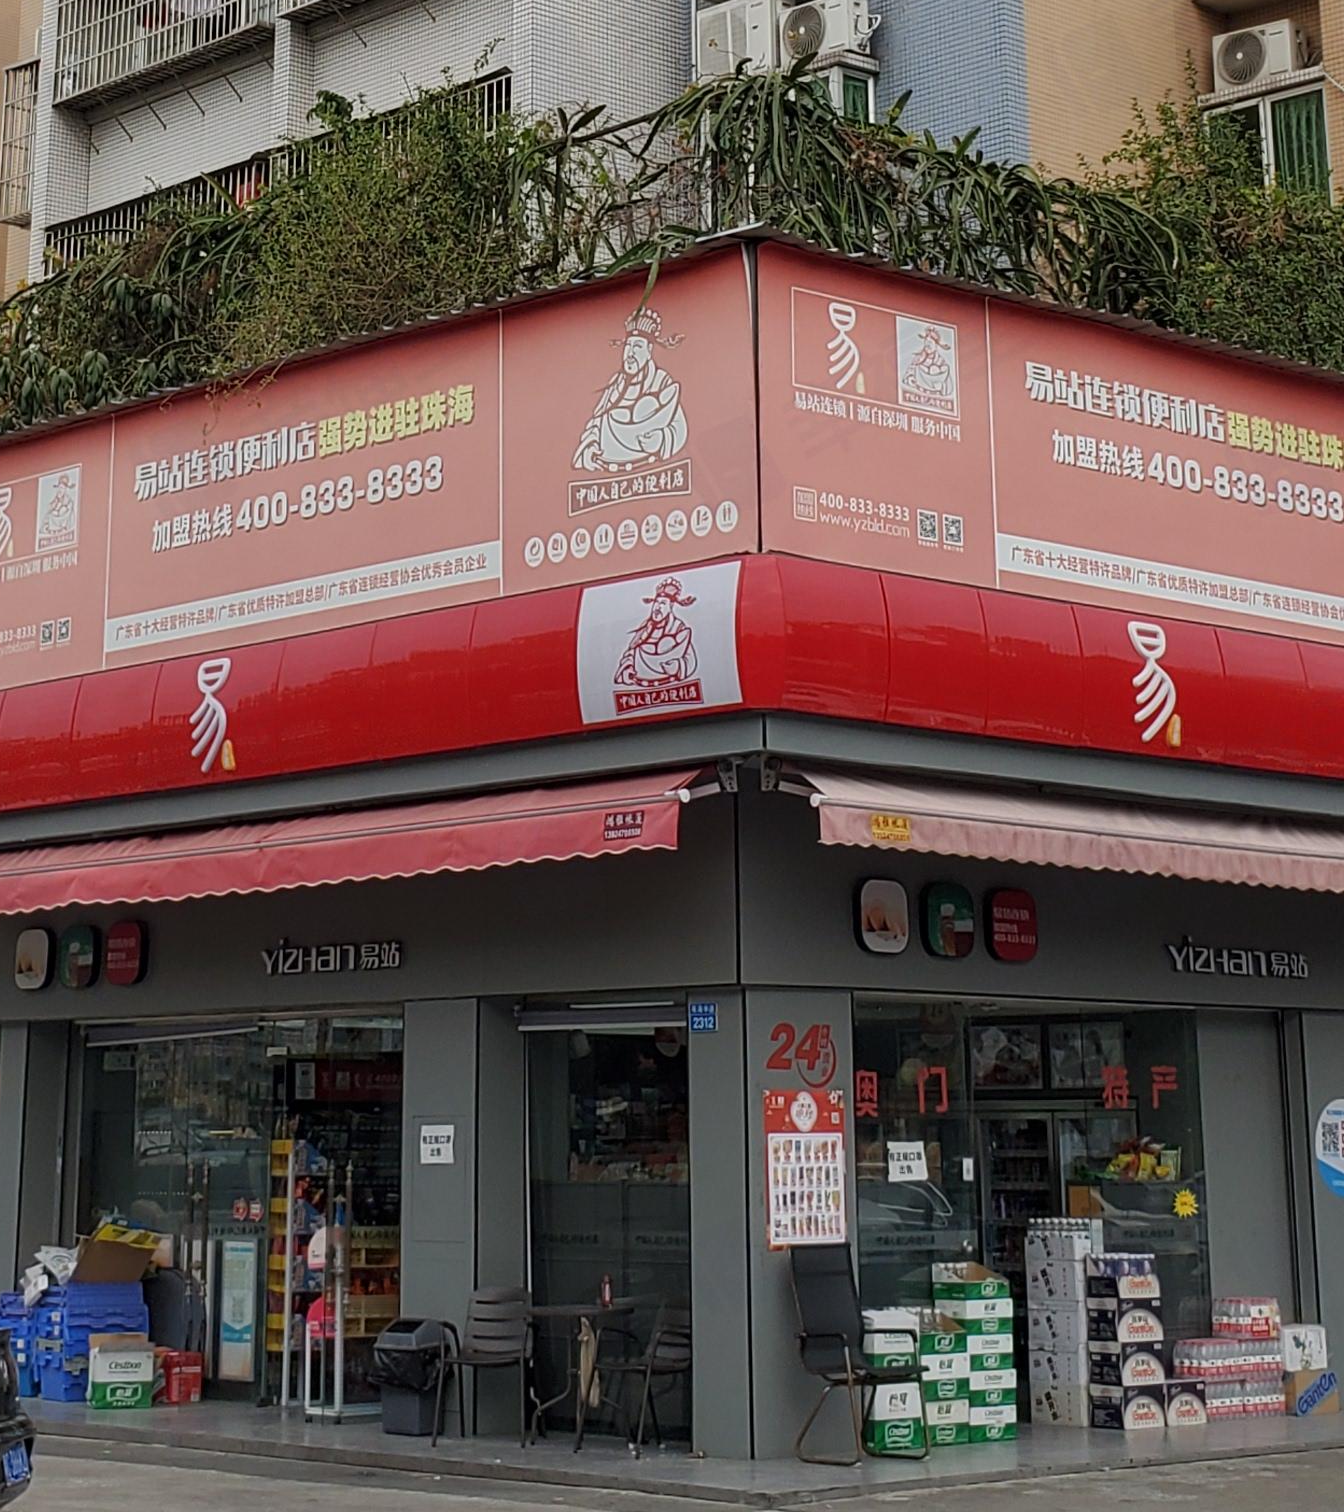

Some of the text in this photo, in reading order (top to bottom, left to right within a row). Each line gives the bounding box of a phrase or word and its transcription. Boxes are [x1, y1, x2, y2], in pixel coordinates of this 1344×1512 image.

[911, 416, 961, 442] 服务中国
[575, 468, 684, 507] 中国人自己的便利店
[819, 491, 910, 522] 400-833-8333
[359, 942, 401, 971] 易站
[1269, 952, 1308, 980] 易站
[693, 1016, 715, 1030] 2312
